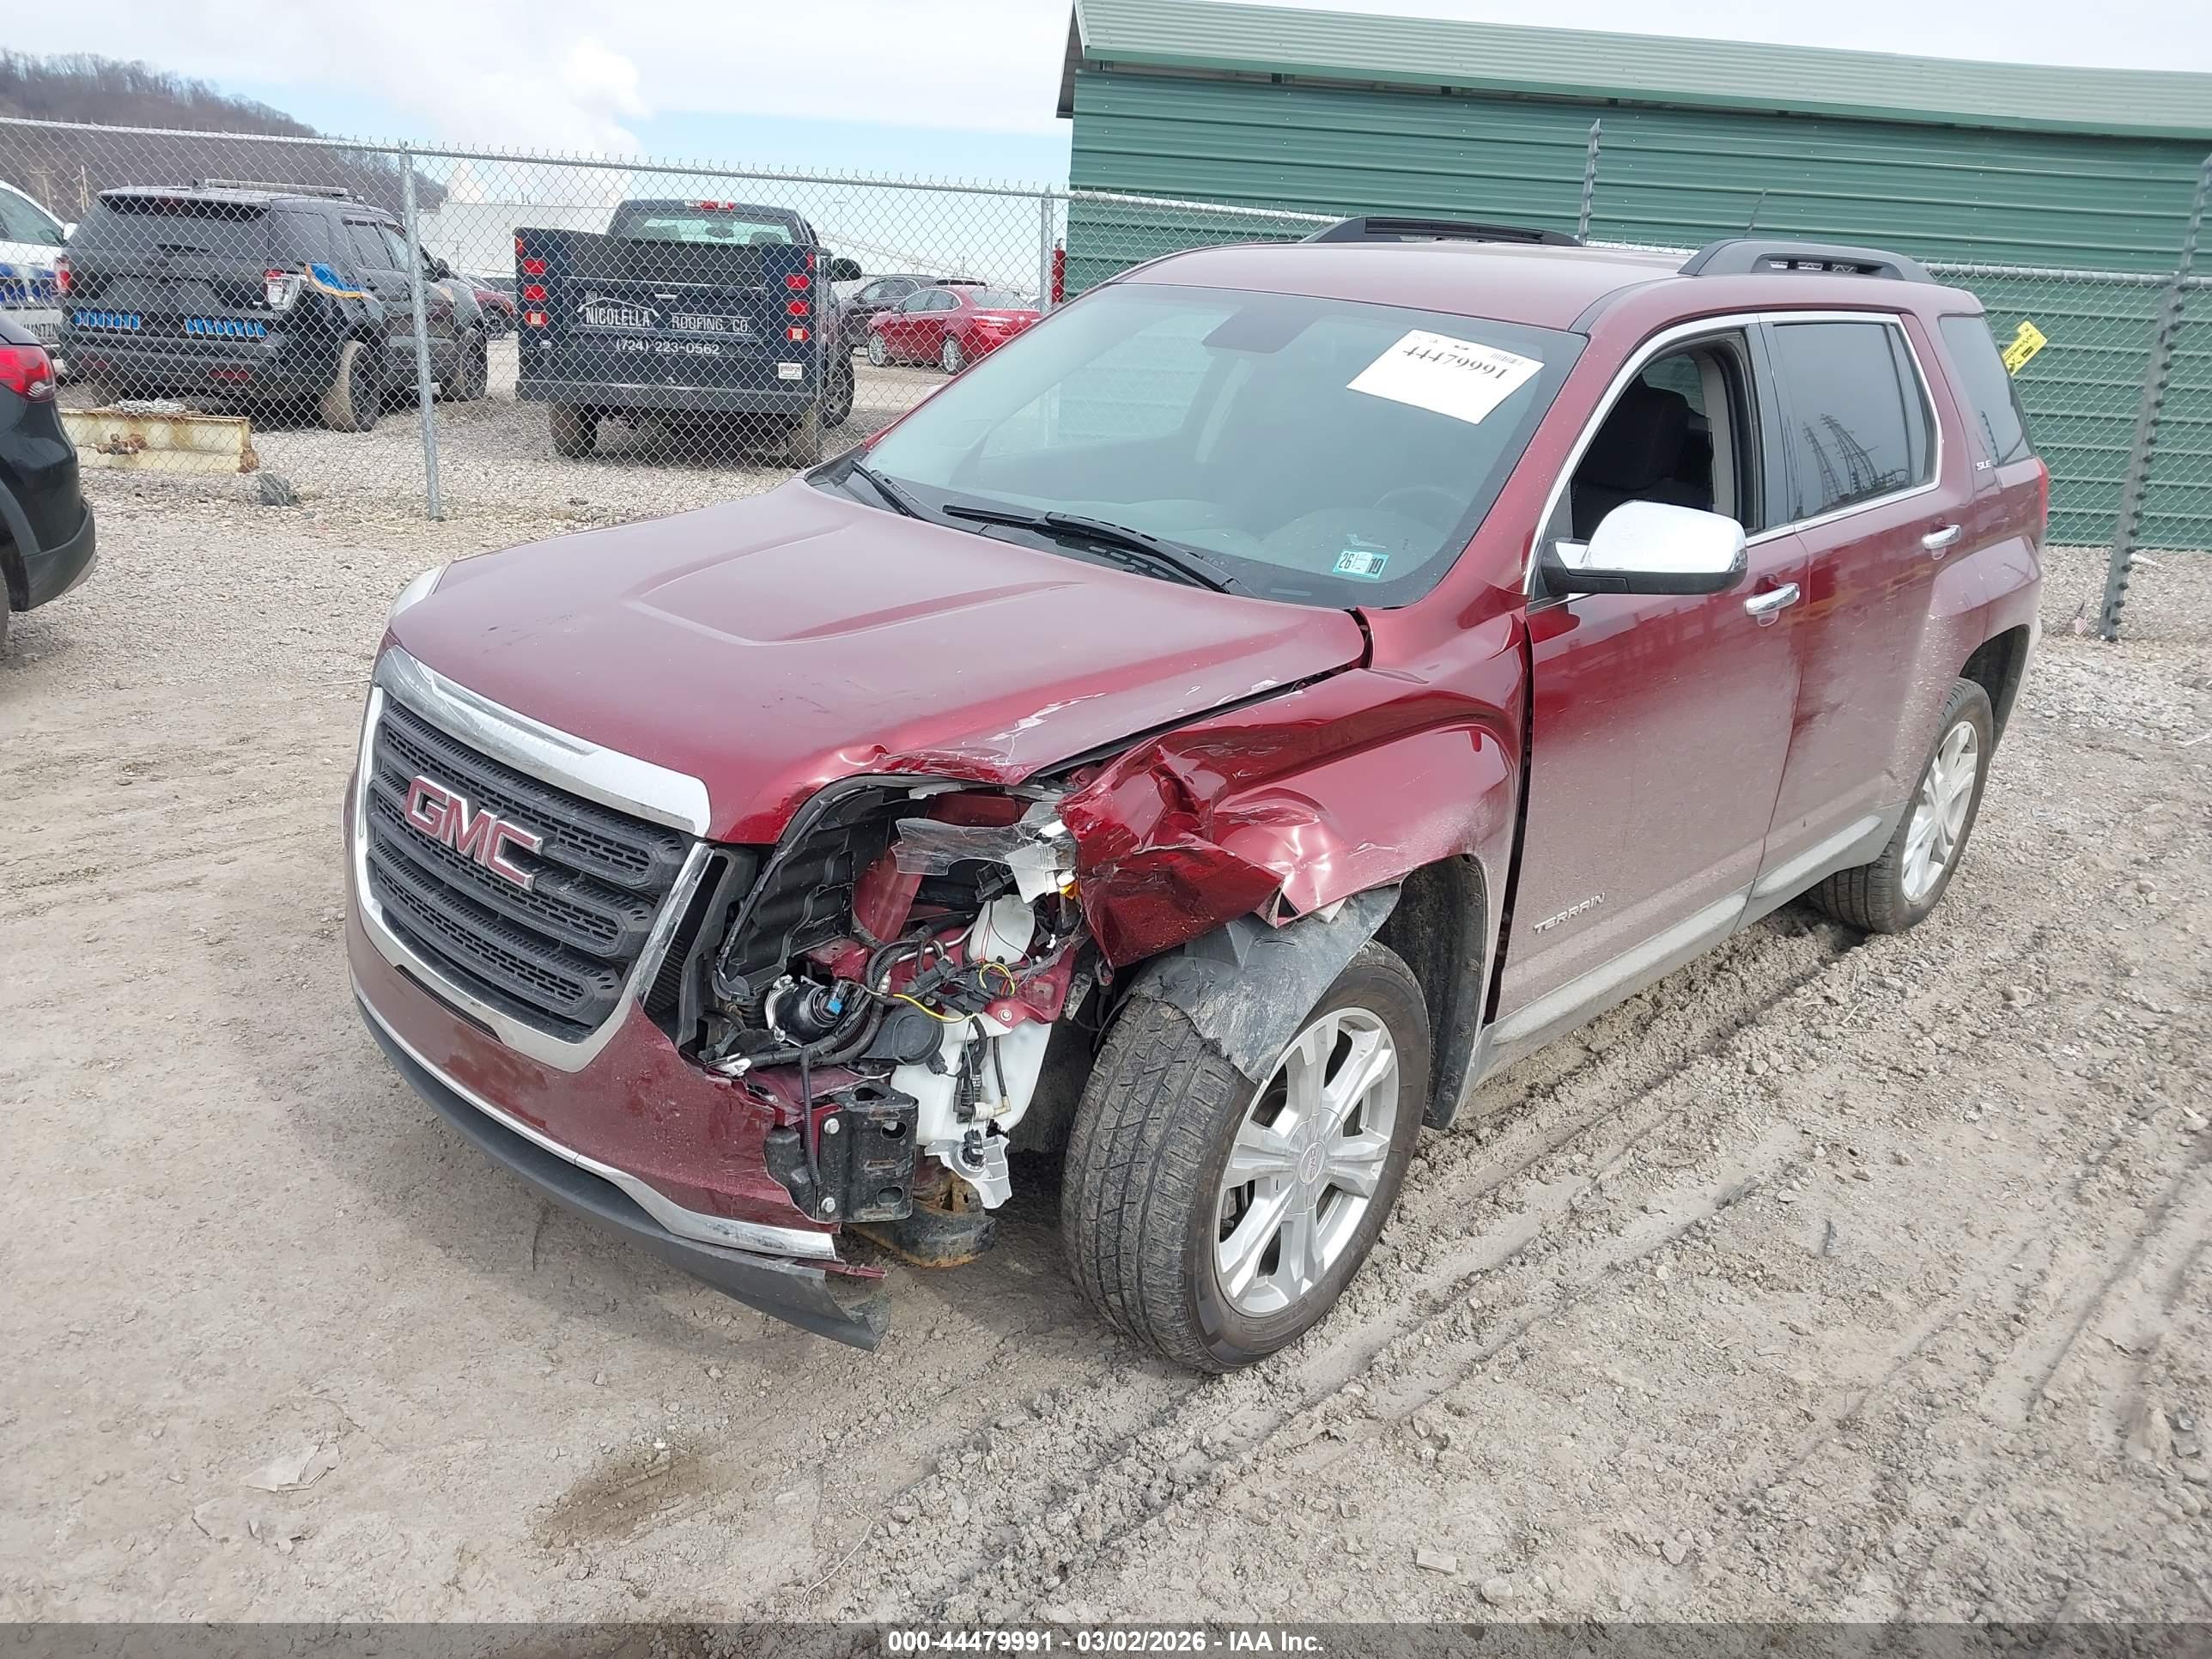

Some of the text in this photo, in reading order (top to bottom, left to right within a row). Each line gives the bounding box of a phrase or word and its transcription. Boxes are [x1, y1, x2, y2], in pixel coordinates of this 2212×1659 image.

[586, 307, 650, 327] NICOLELLA
[672, 315, 751, 333] ROOFING CO.
[616, 337, 720, 355] (724) 223-0562
[1403, 345, 1508, 380] 44479991
[1976, 459, 1992, 471] SLE
[1338, 552, 1355, 569] 26
[404, 775, 543, 892] GMC
[1533, 892, 1606, 934] TERRAIN
